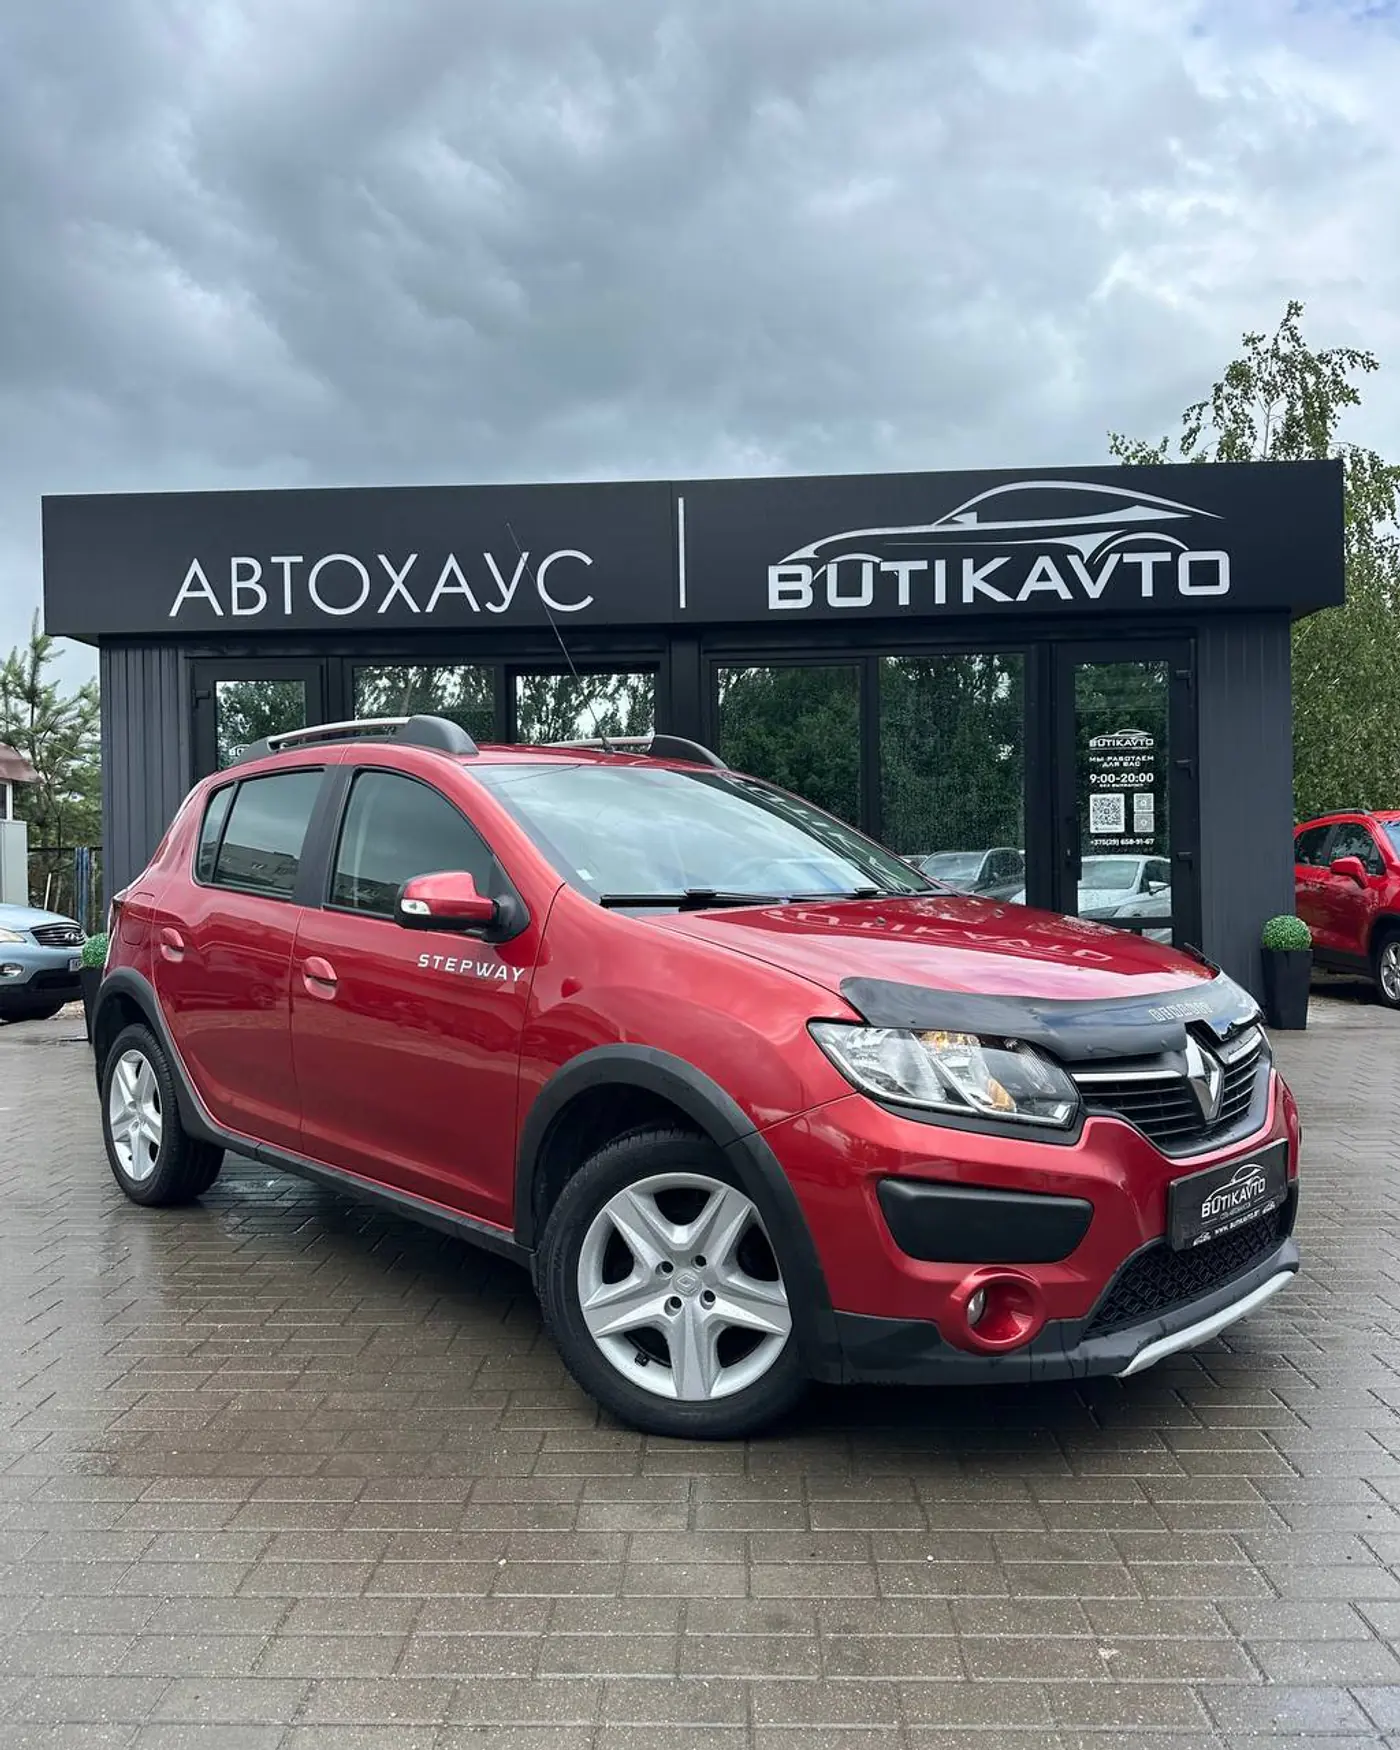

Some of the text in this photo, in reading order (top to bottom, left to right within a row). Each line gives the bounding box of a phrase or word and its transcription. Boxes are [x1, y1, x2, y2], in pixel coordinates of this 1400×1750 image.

[168, 549, 595, 617] АВТОХАУС
[767, 549, 1231, 610] BUTIKAVTO
[1089, 738, 1154, 748] BUTIKAVTO
[1089, 772, 1154, 784] 9:00-20:00
[417, 953, 526, 982] STEPWAY
[1201, 1178, 1266, 1218] BUTIKAVTO
